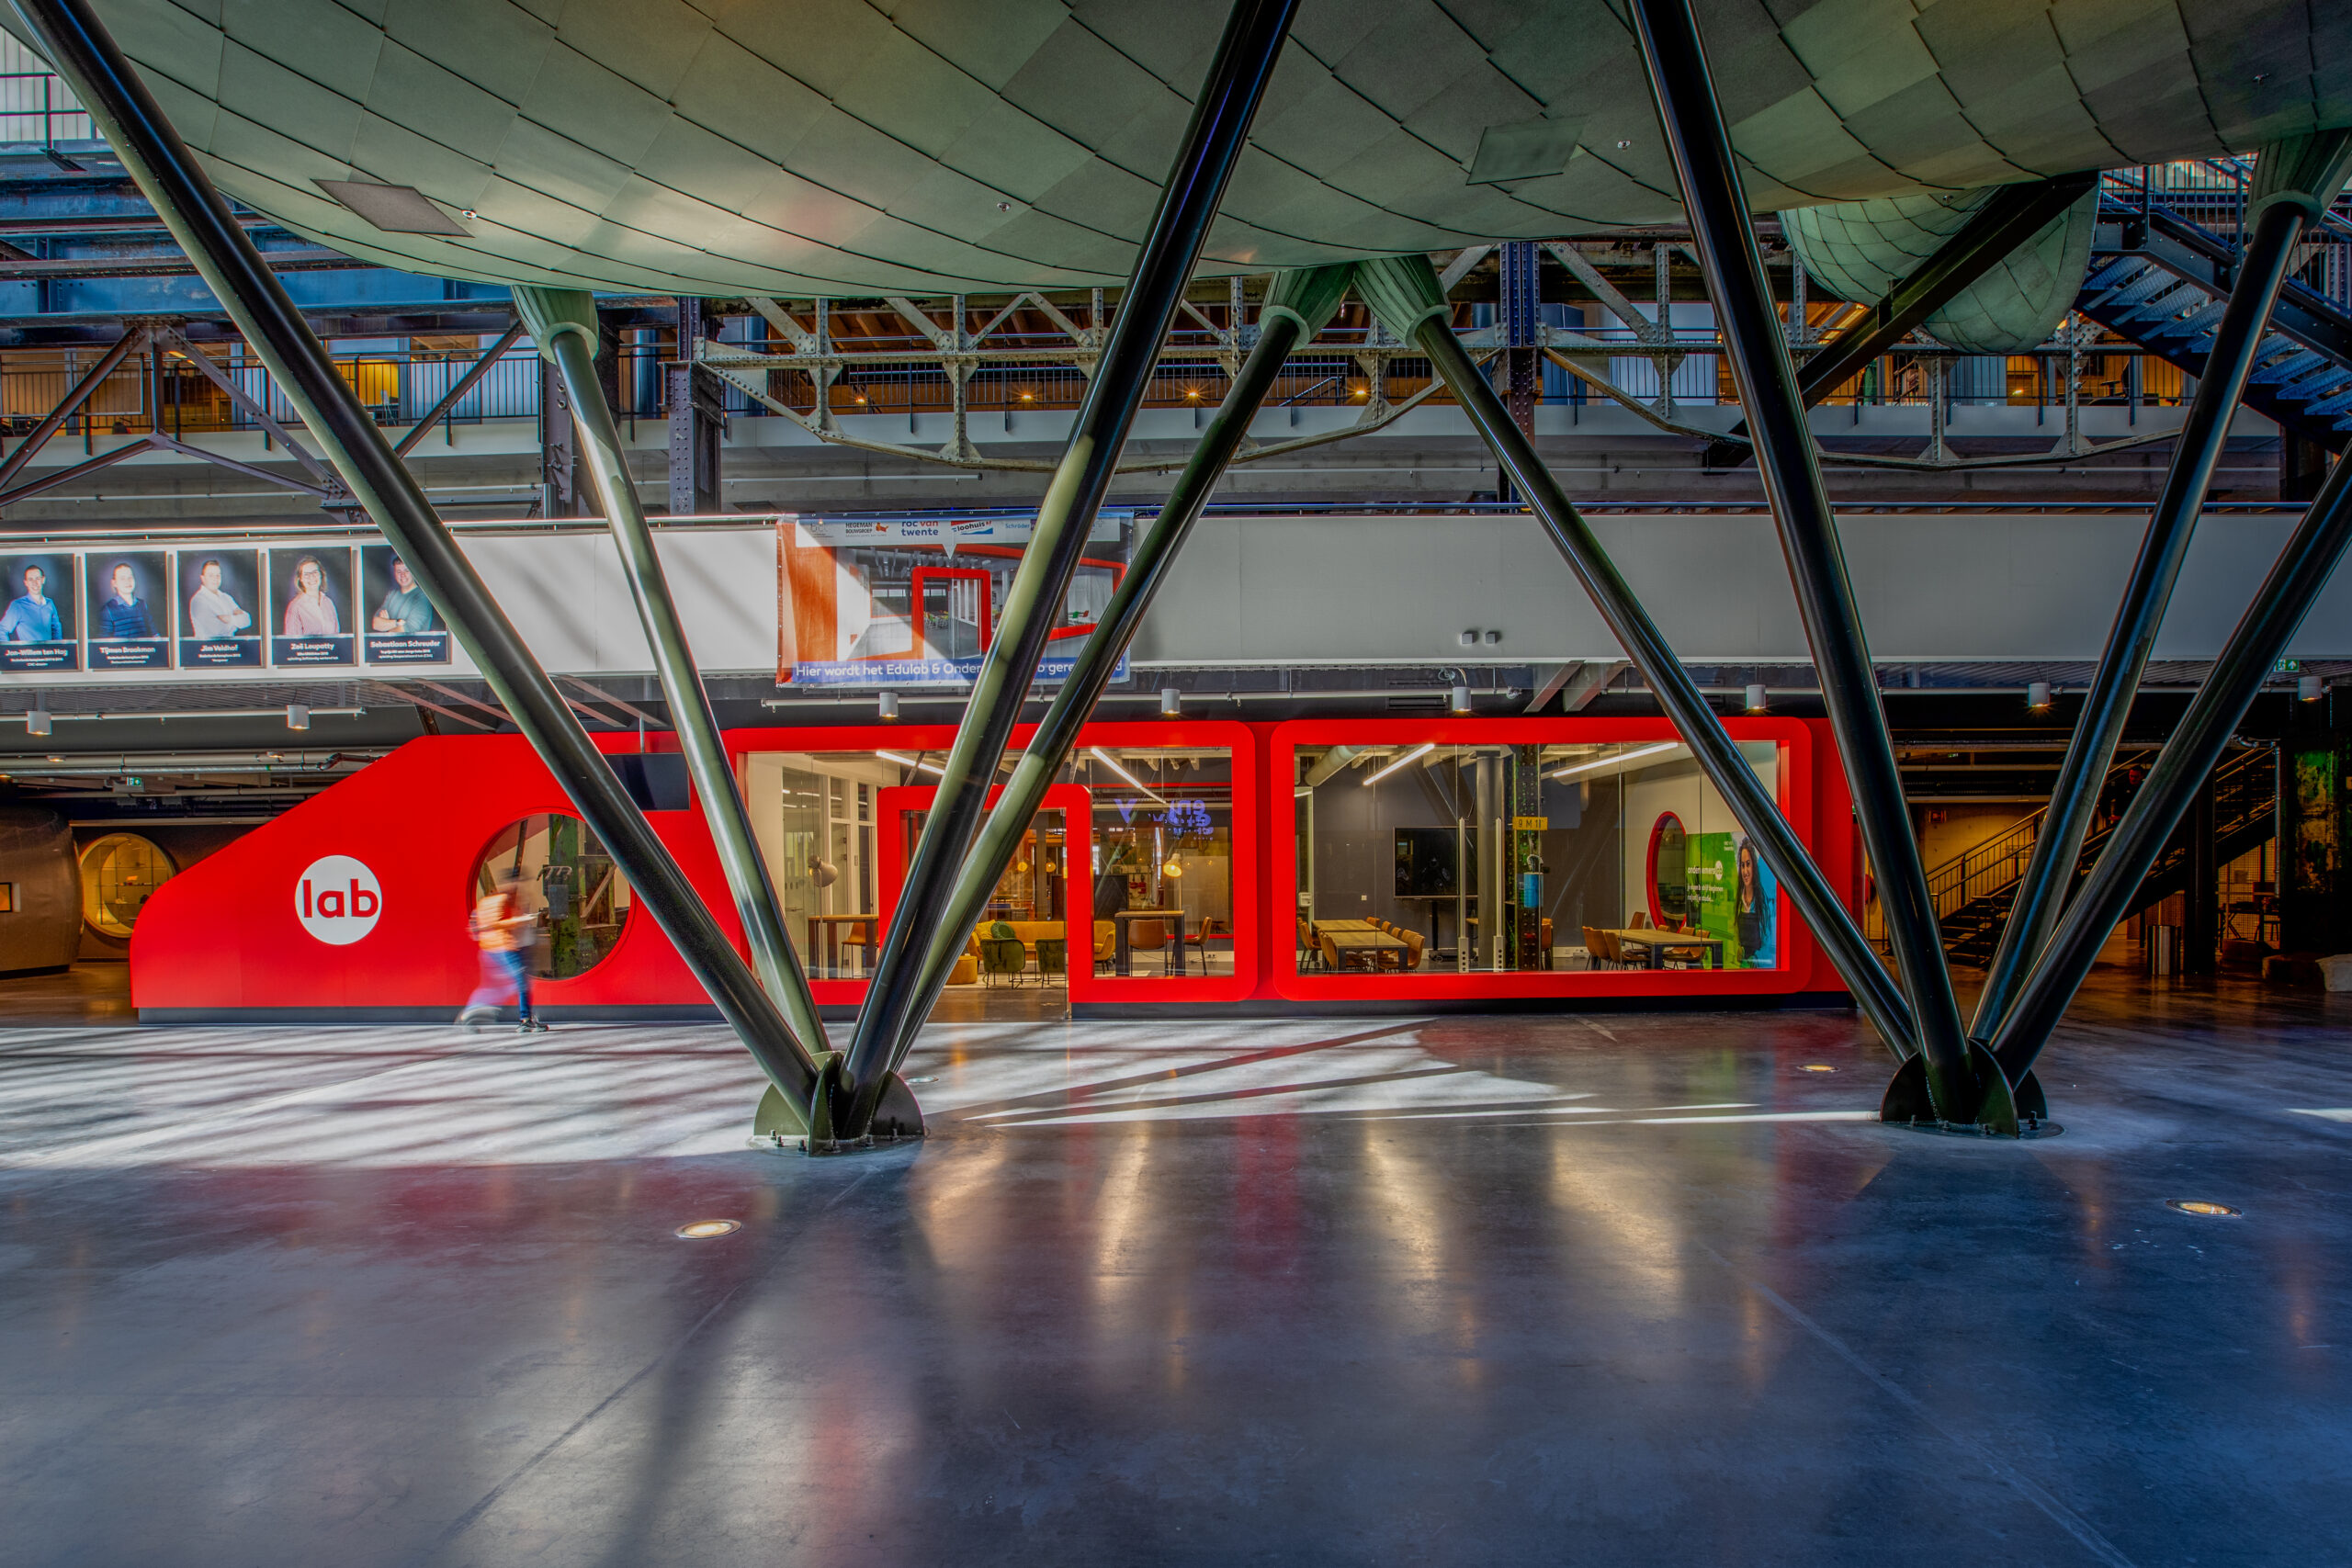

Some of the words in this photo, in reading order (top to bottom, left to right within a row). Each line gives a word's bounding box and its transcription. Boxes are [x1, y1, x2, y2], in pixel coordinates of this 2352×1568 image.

[901, 527, 939, 536] twente
[956, 521, 986, 532] loohuis
[796, 665, 821, 676] Hier
[824, 665, 860, 676] wordt
[863, 664, 883, 676] het
[887, 664, 929, 675] Edulab
[932, 663, 940, 673] &
[302, 878, 379, 919] lab
